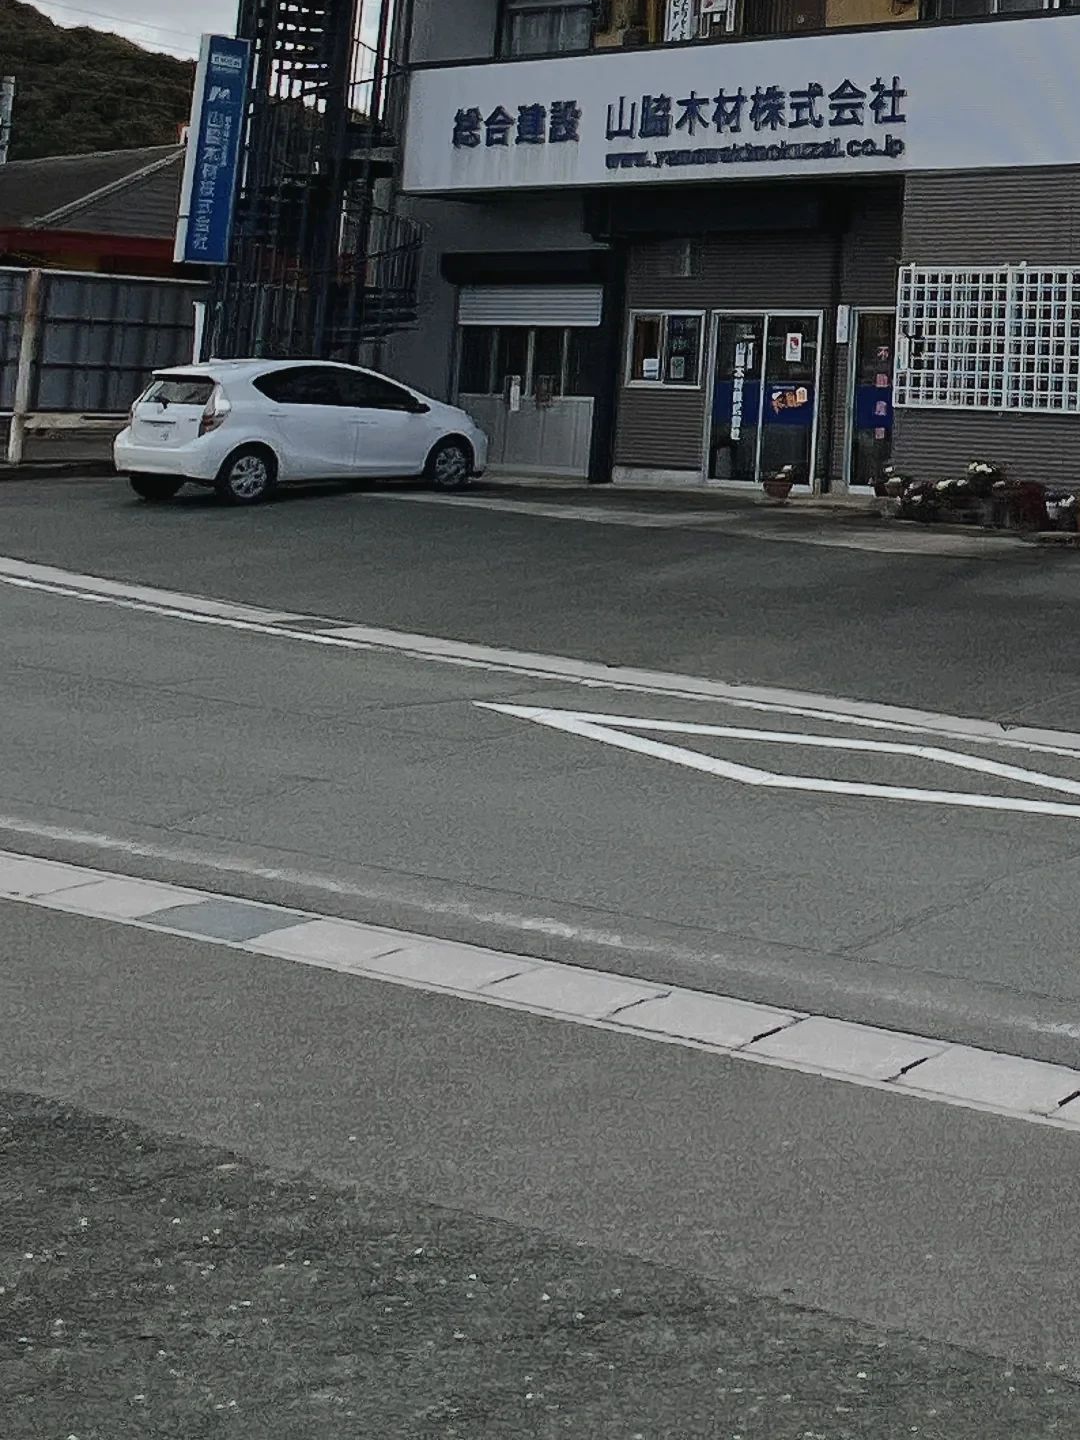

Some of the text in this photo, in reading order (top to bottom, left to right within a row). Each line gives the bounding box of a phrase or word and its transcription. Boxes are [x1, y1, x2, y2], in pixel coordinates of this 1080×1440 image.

[605, 76, 907, 140] 山脇木材株式会社
